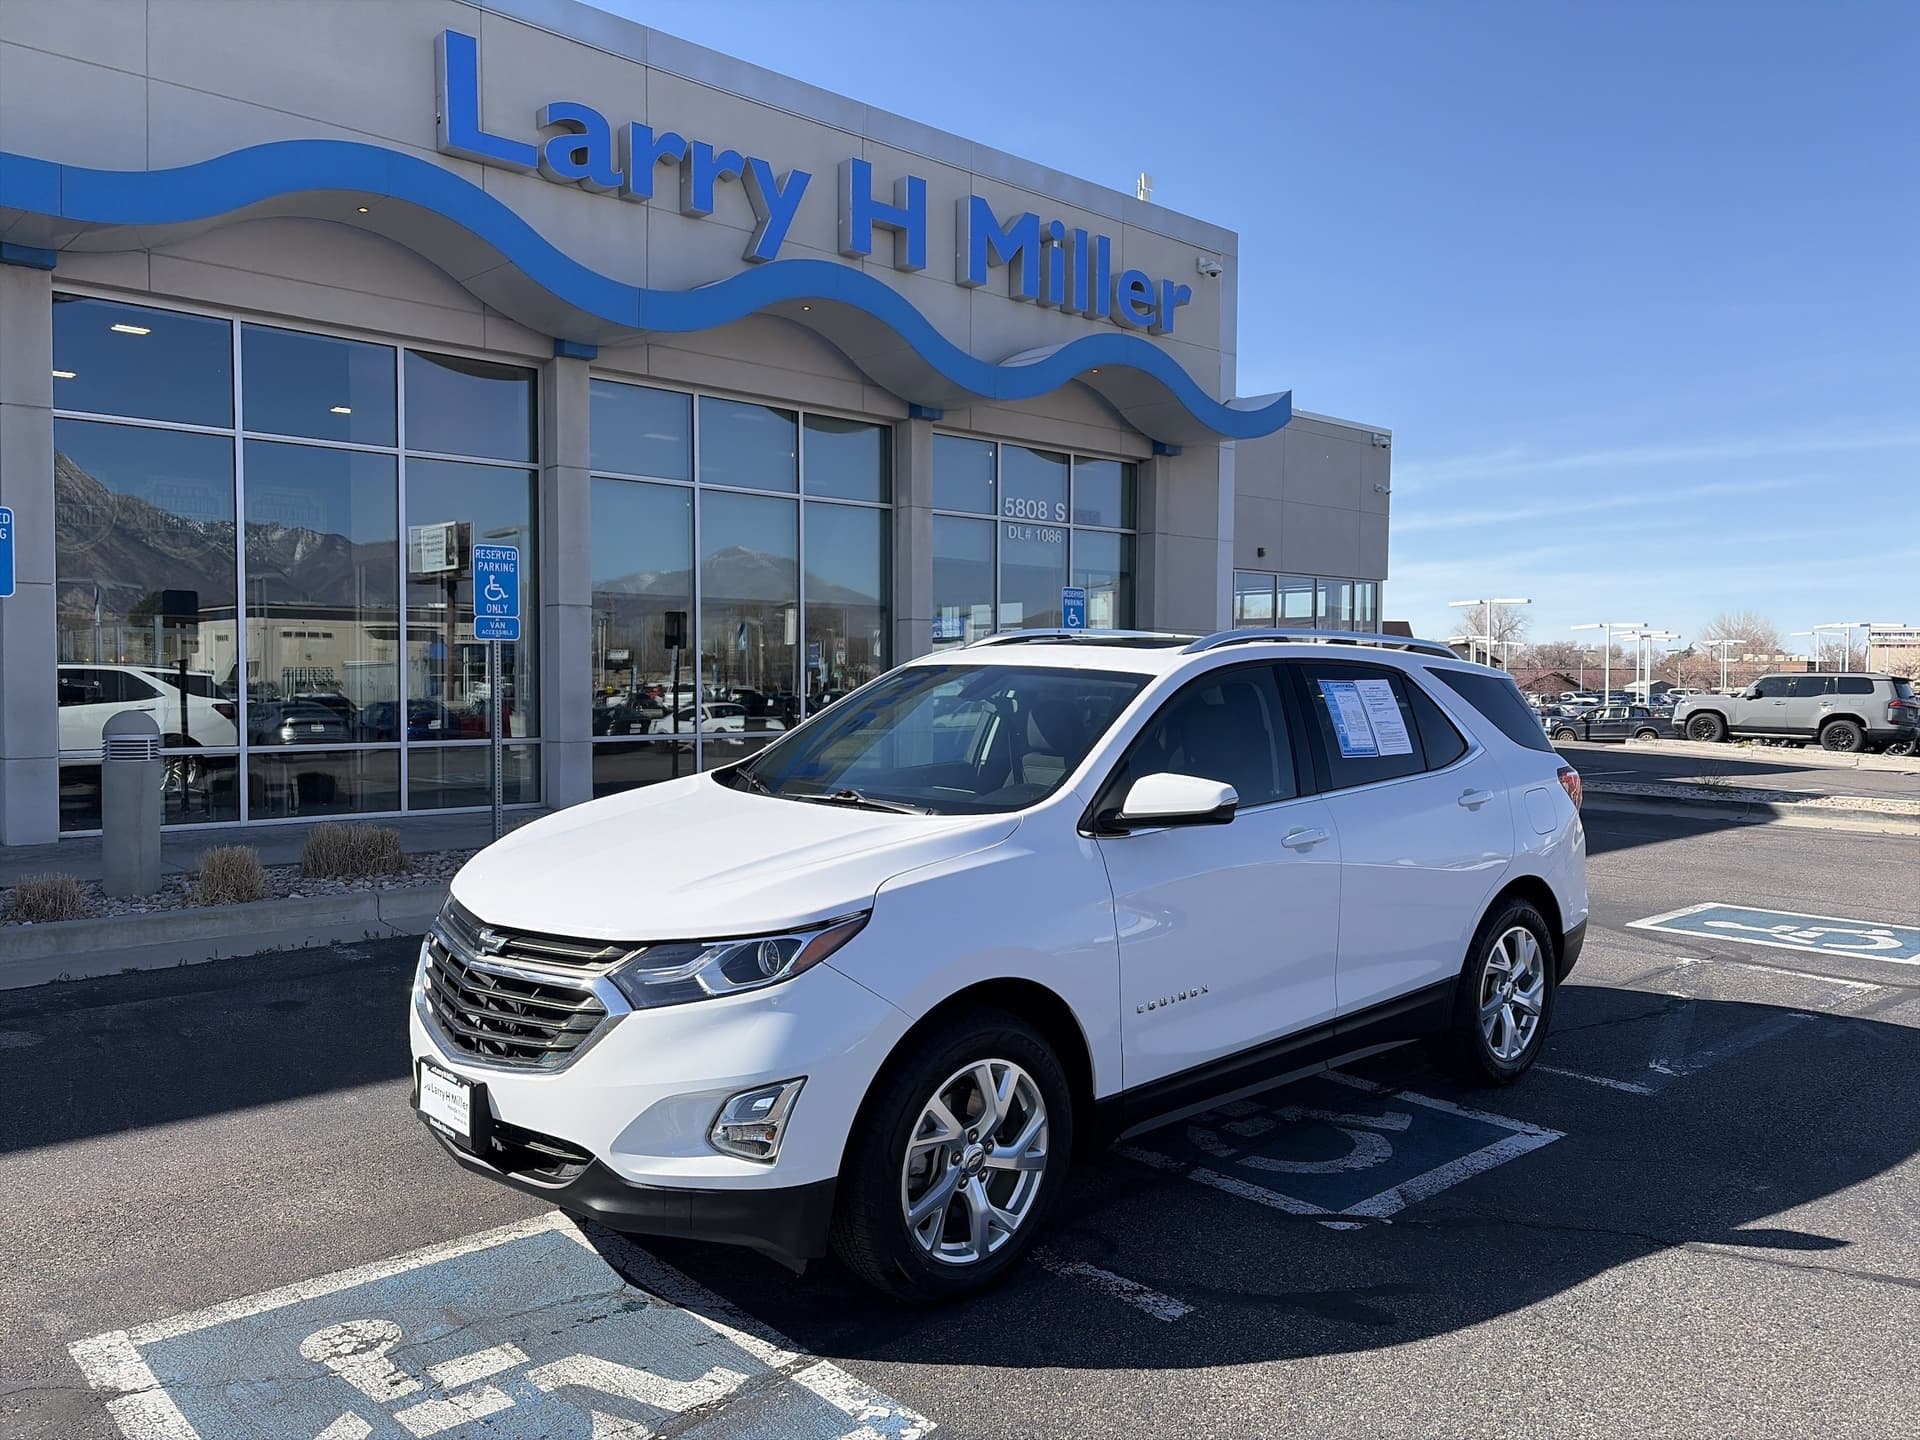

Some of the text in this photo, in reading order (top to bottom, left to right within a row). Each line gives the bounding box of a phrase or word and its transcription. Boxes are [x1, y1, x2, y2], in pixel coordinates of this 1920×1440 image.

[441, 29, 1193, 334] Larry H Miller
[1004, 497, 1066, 522] 5808 S
[1008, 525, 1063, 544] DL# 1086
[475, 549, 517, 561] RESERVED
[478, 561, 515, 573] PARKING
[486, 603, 509, 614] ONLY
[489, 621, 506, 629] VAN
[1136, 984, 1209, 1015] EQUINOX
